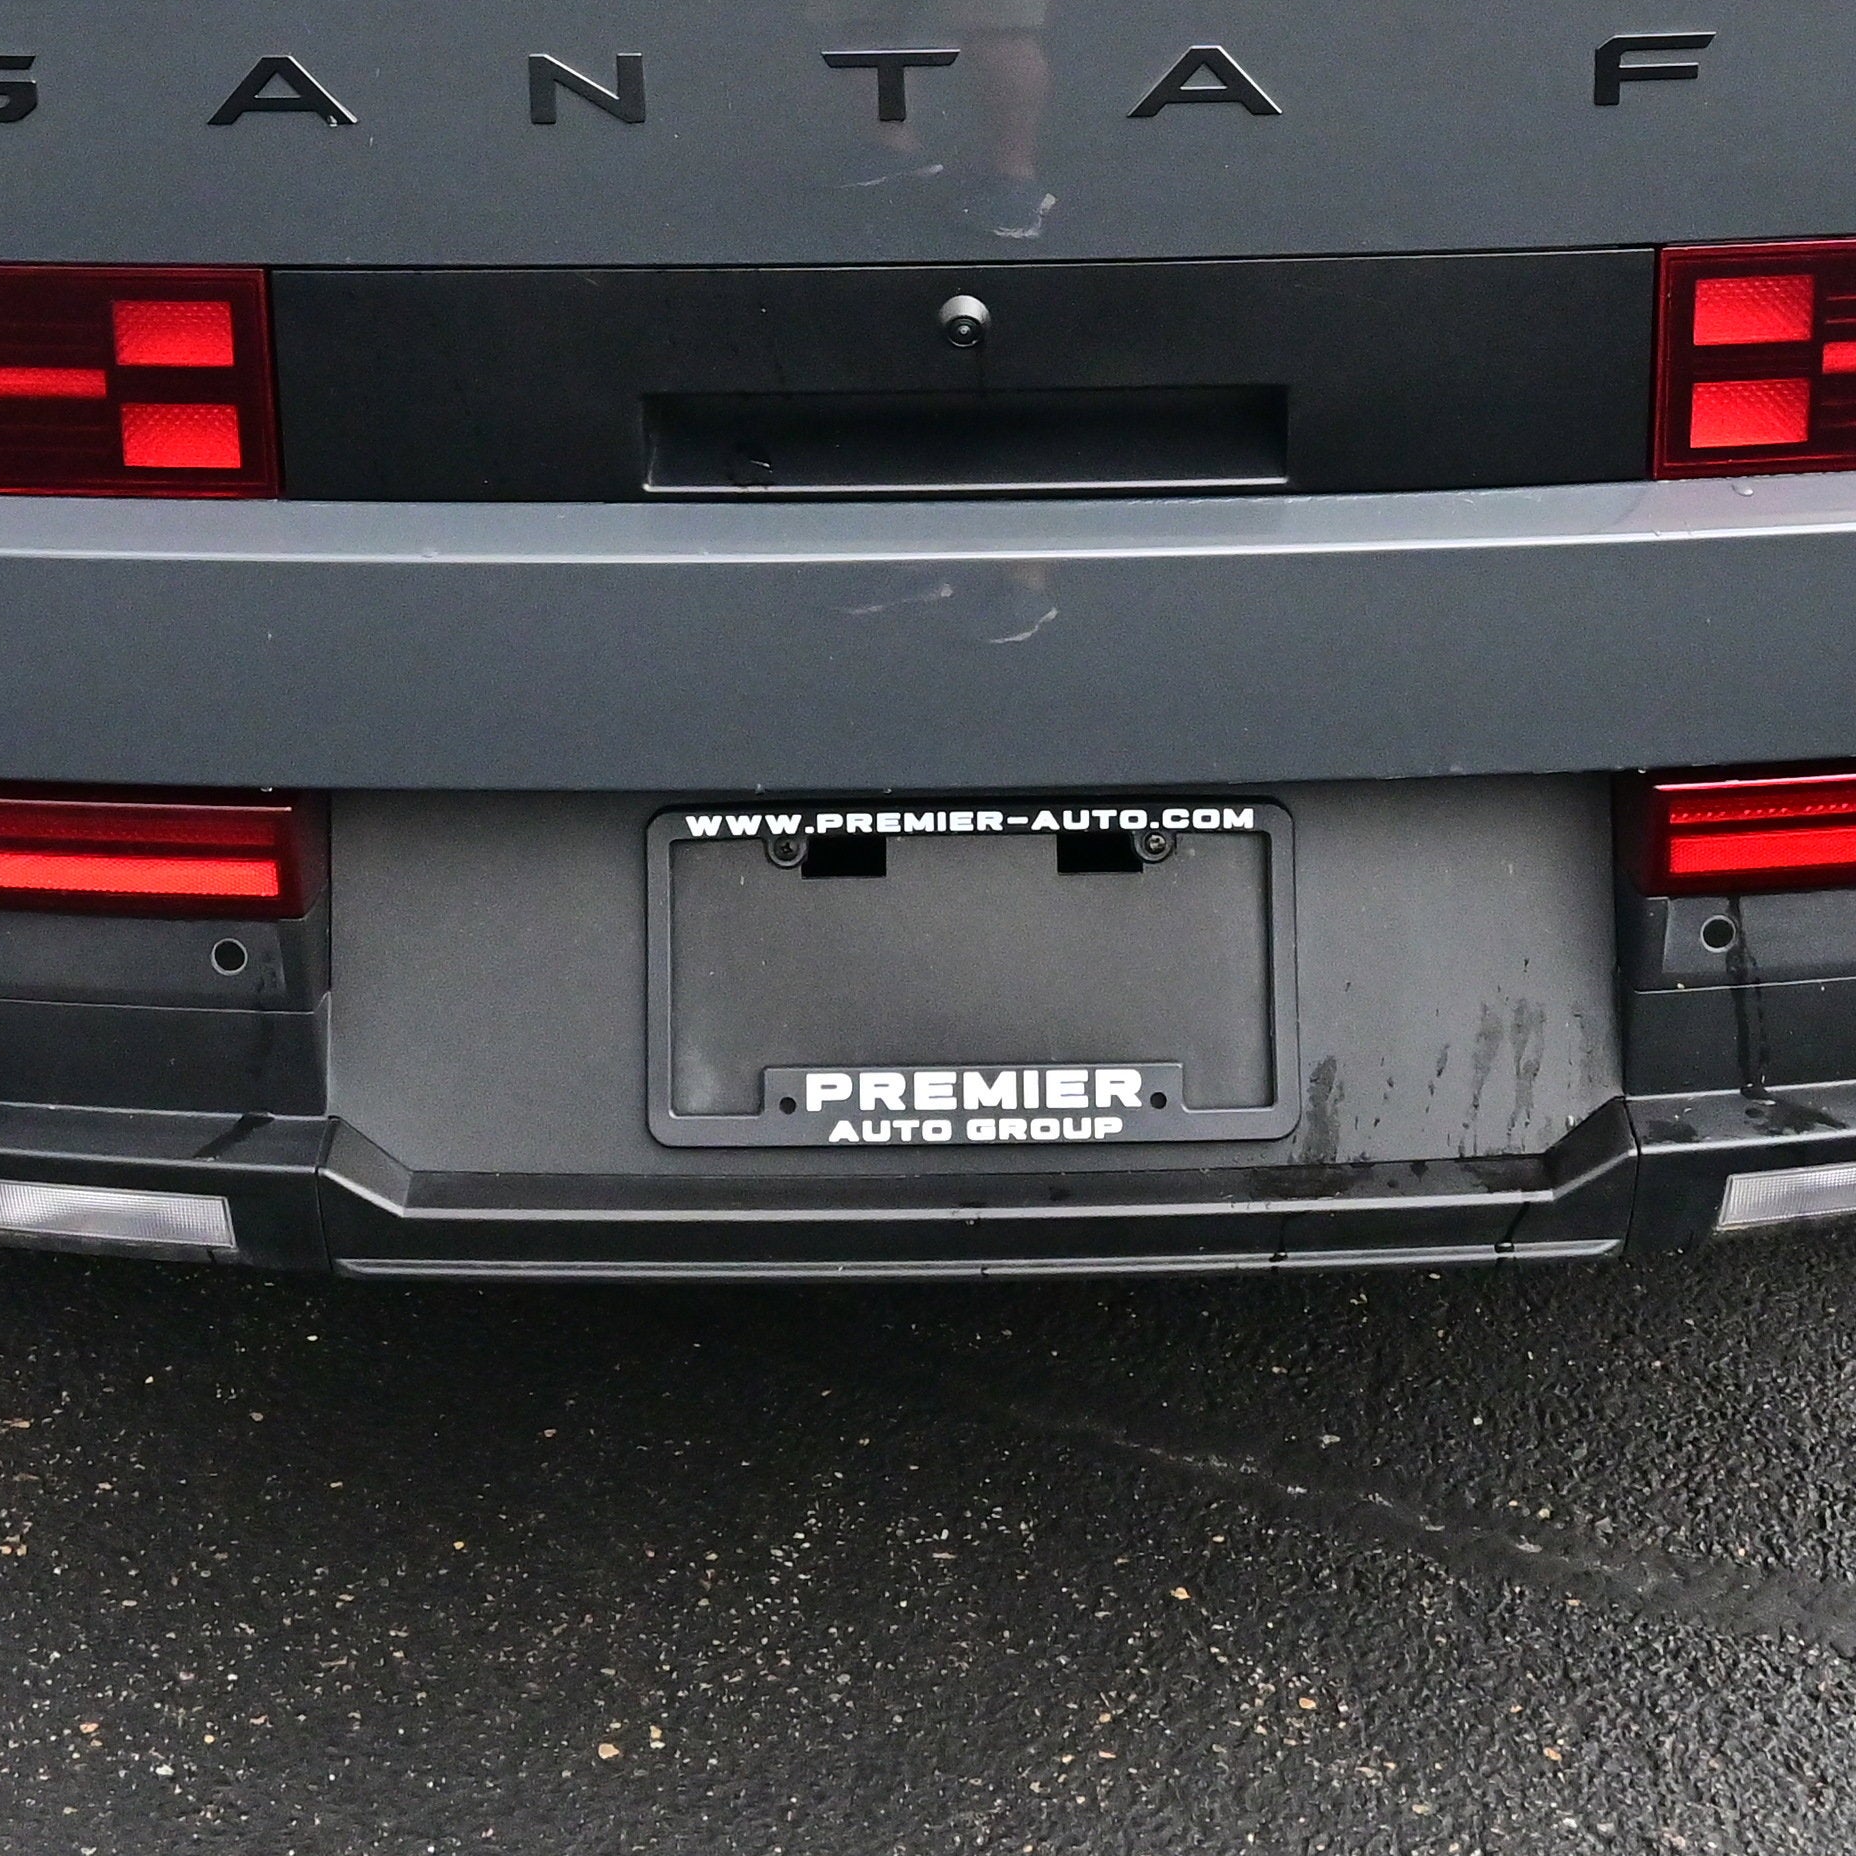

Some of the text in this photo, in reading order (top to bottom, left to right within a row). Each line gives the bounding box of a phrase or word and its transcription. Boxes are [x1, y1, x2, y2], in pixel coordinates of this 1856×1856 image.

[685, 808, 1255, 837] WWW.PREMIER-AUTO.COM
[805, 1068, 1143, 1113] PREMIER
[828, 1116, 1124, 1143] AUTO GROUP
